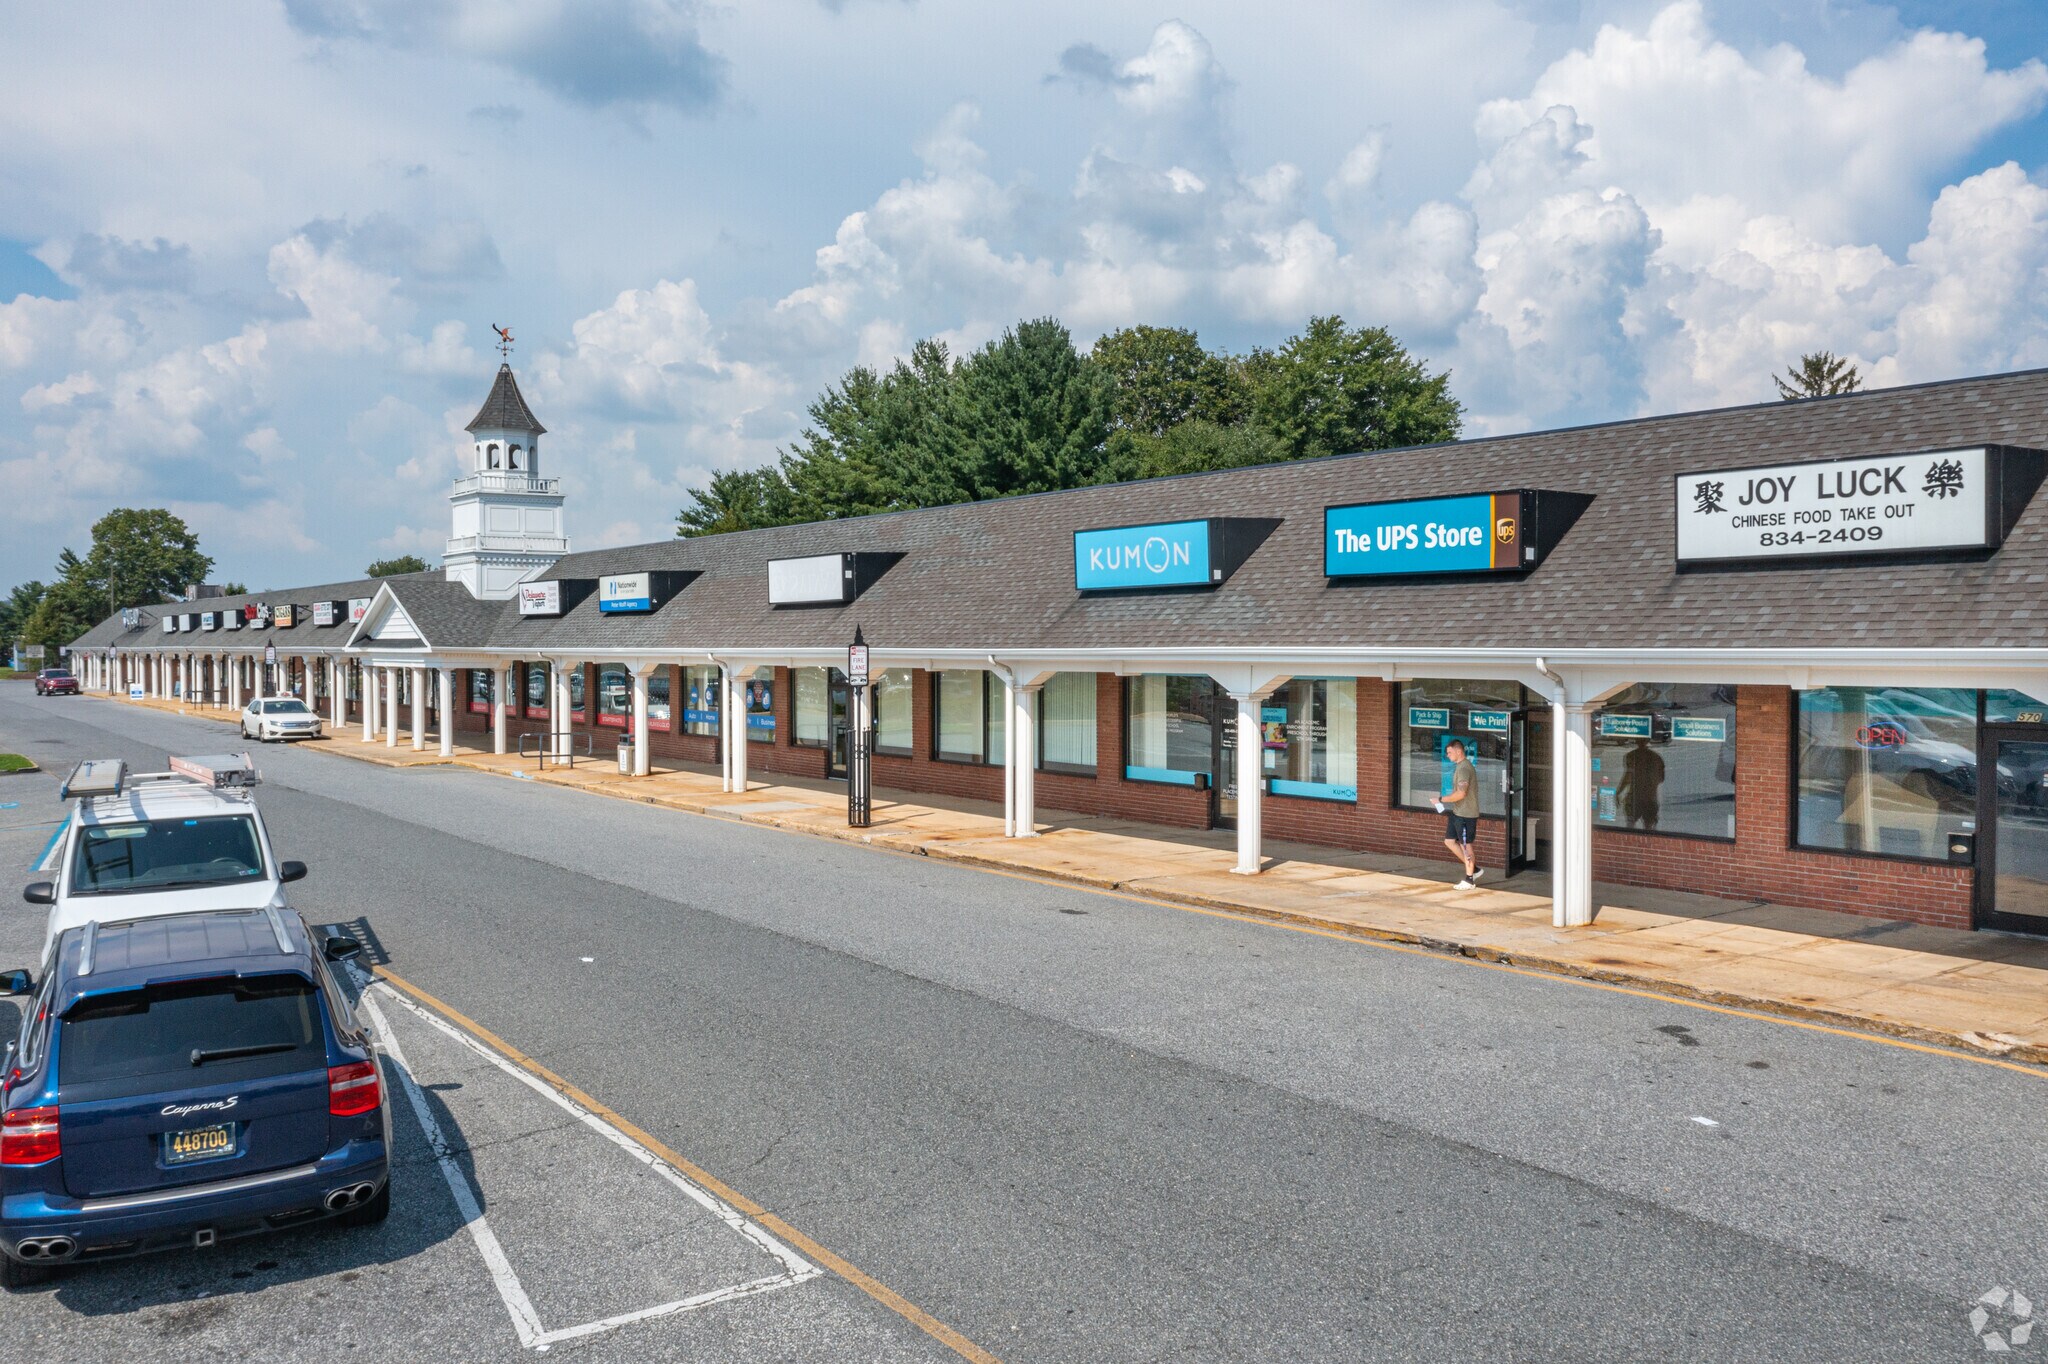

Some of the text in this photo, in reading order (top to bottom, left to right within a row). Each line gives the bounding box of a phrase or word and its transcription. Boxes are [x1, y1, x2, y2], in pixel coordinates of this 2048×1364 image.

[1738, 466, 1906, 506] JOY LUCK
[1921, 458, 1965, 500] 樂
[1693, 479, 1728, 515] 聚
[1732, 503, 1915, 529] CHINESE FOOD TAKE OUT
[1335, 521, 1482, 554] The UPS Store
[1498, 525, 1515, 541] ups
[1760, 526, 1883, 547] 834-2409
[1090, 536, 1189, 574] KUMON
[1474, 716, 1487, 726] We
[1695, 722, 1720, 730] Business
[2019, 713, 2041, 722] 570
[1685, 729, 1712, 737] Solutions
[1855, 726, 1906, 746] OPEN
[1332, 789, 1356, 797] KUMON
[160, 1095, 239, 1117] Cayenne S
[173, 1130, 228, 1154] 448700
